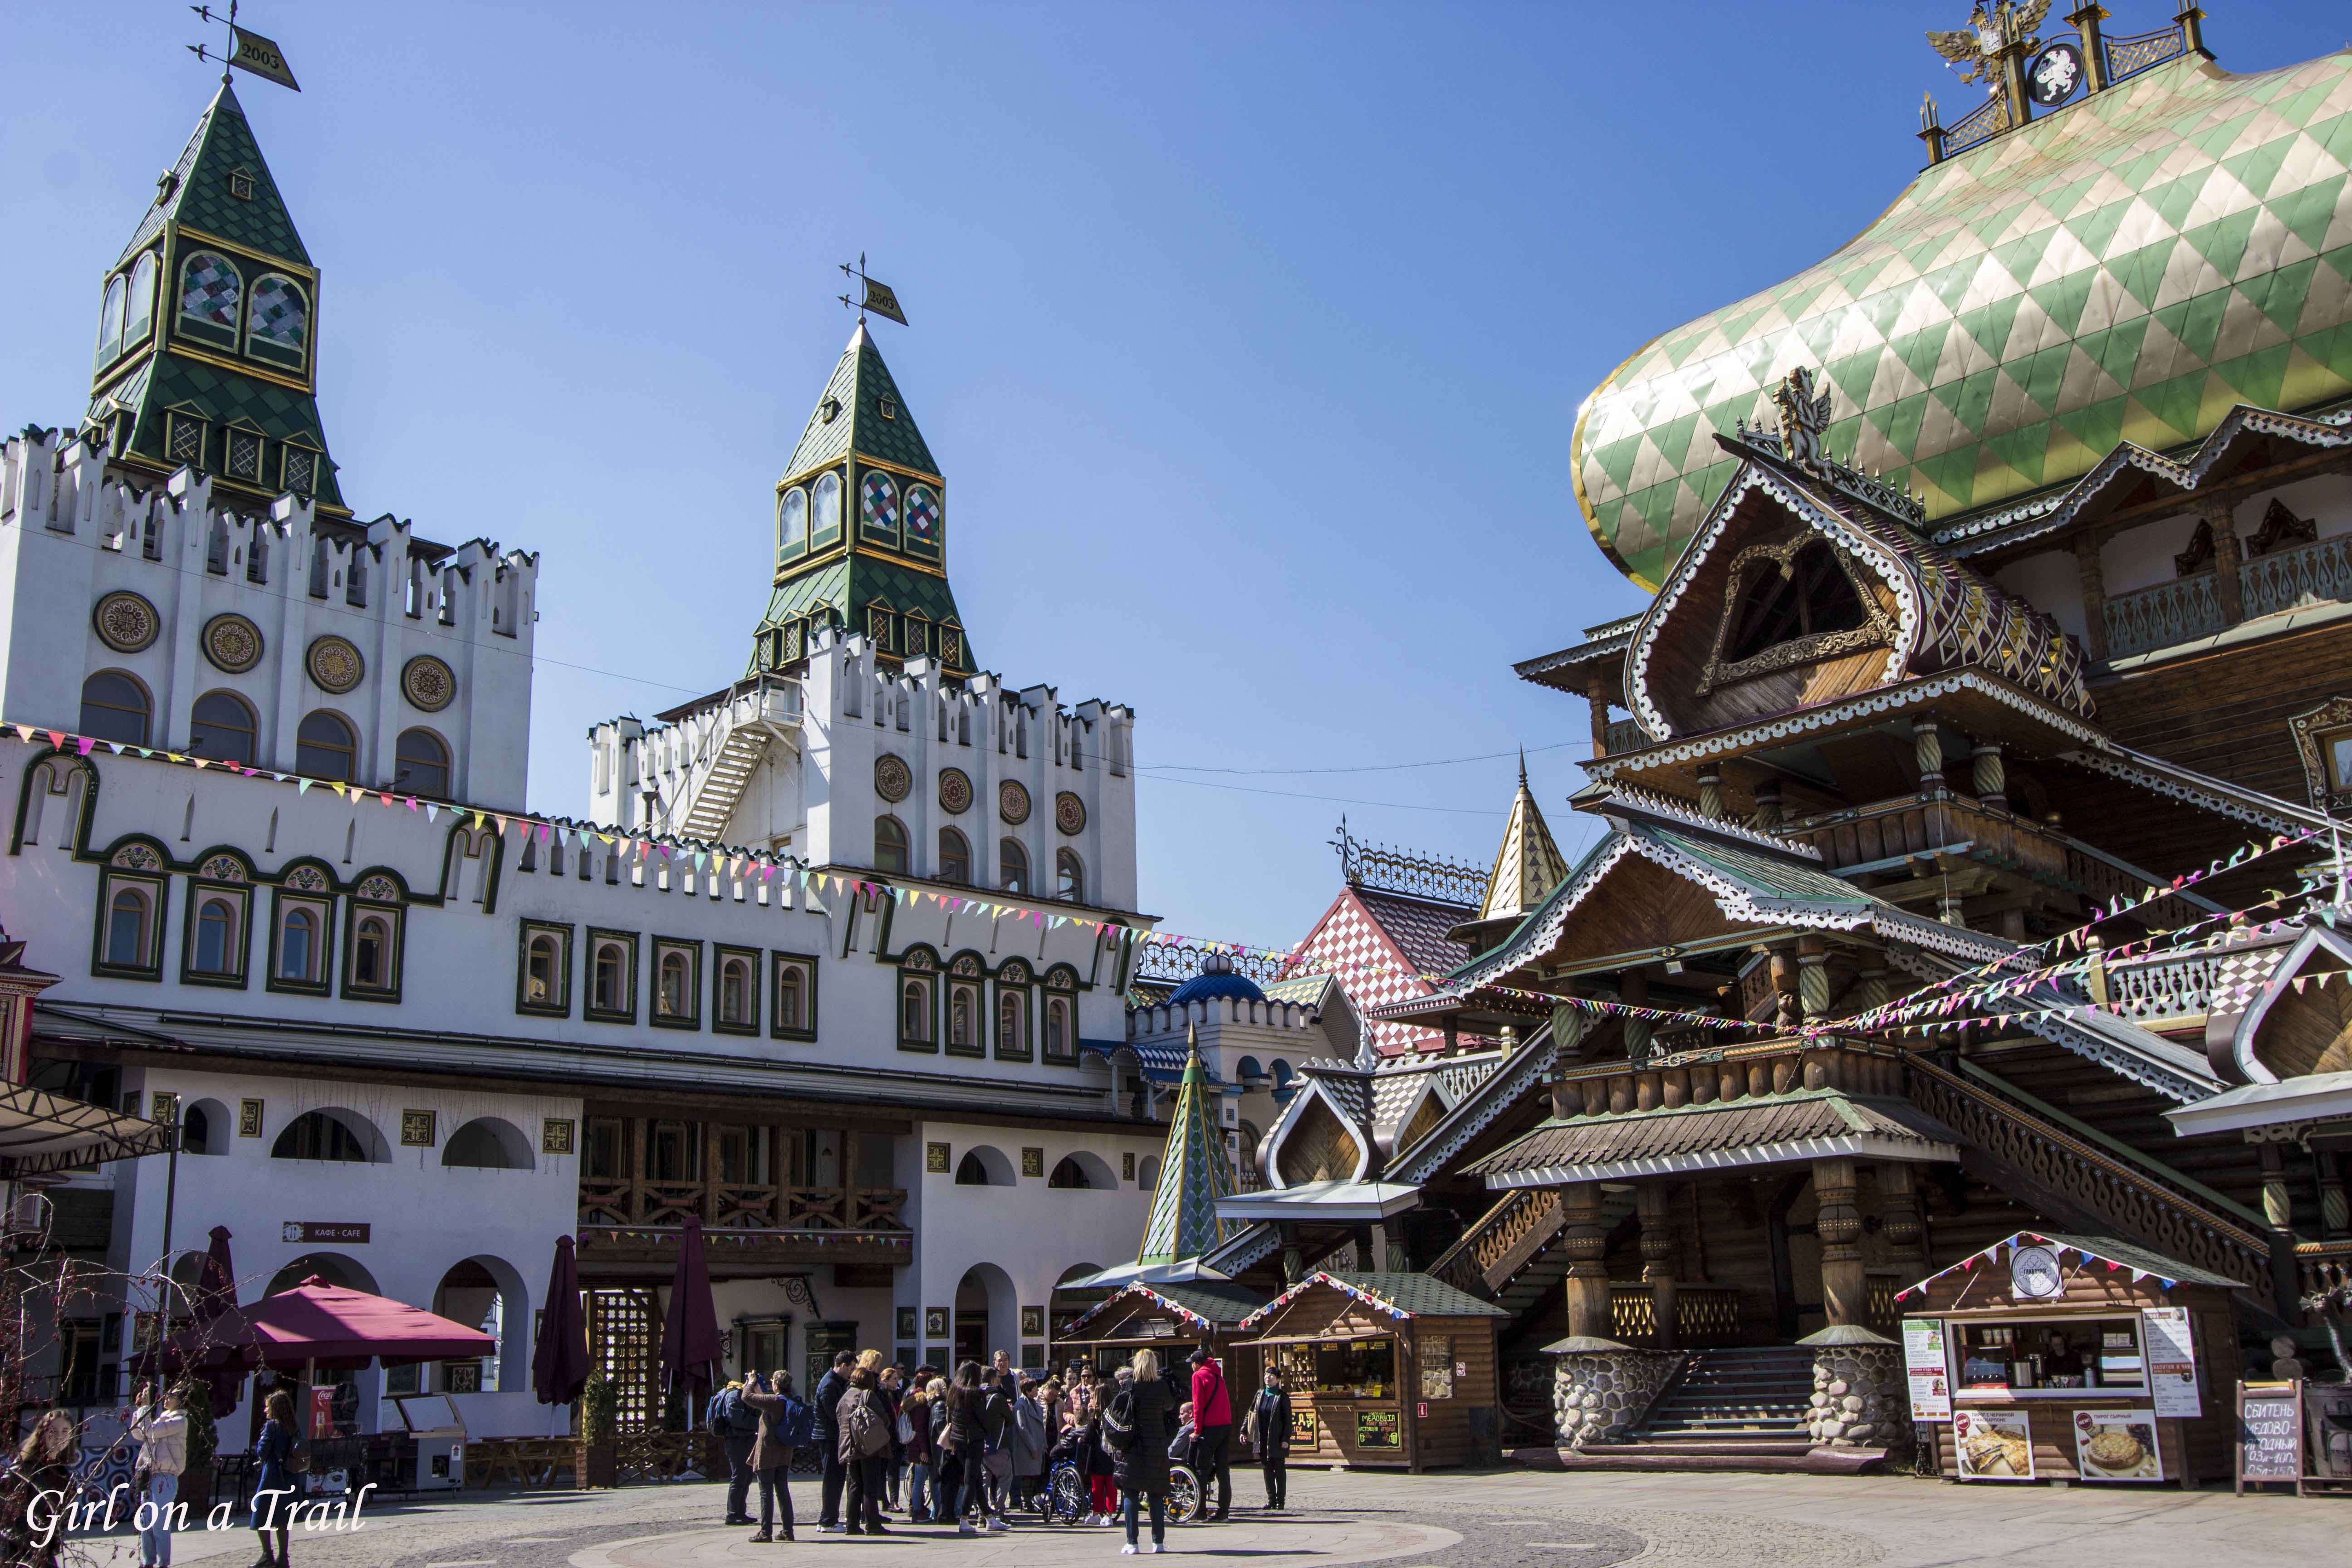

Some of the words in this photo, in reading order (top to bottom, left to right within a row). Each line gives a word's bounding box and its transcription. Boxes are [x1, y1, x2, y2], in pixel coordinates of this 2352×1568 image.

[242, 44, 279, 69] 2003
[869, 291, 894, 309] 2003
[2244, 1403, 2294, 1419] СБИТЕНЬ
[2245, 1421, 2297, 1435] МЕДОВО-
[2244, 1437, 2297, 1451] ЯГОДНЫЙ
